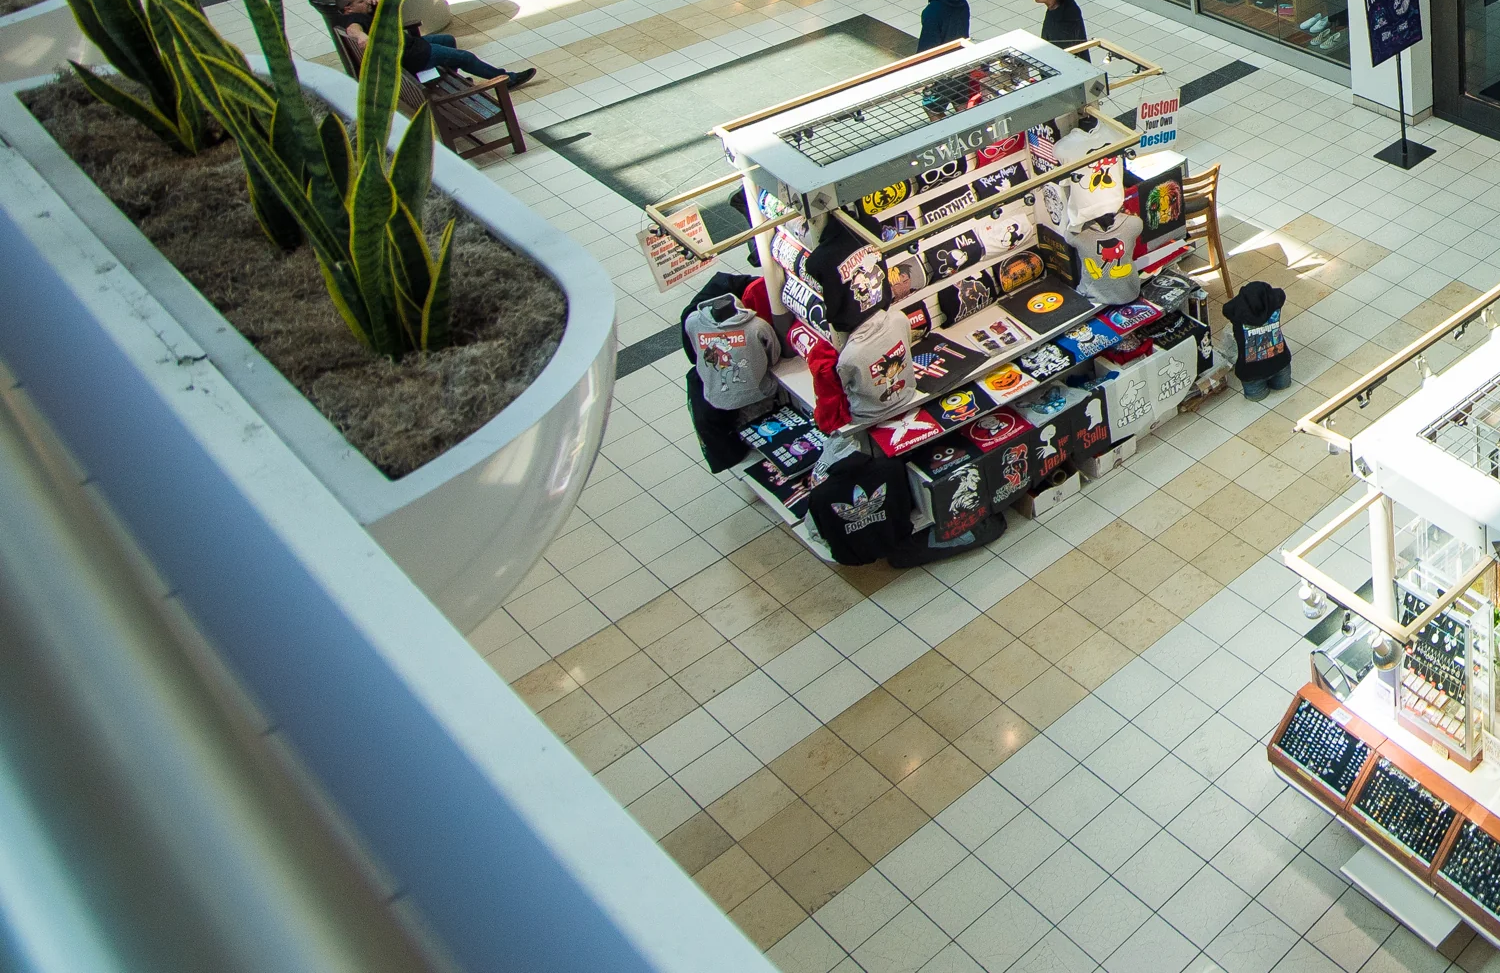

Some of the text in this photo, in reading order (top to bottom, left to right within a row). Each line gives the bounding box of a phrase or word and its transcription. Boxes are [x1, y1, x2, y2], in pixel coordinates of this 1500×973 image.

[1141, 98, 1178, 119] Custom
[1145, 116, 1173, 130] Your Own
[921, 117, 1013, 167] SWAG IT
[1140, 130, 1176, 148] Design
[926, 192, 976, 224] FORTNITE
[666, 273, 683, 286] Youth
[684, 266, 699, 277] Sizes
[789, 279, 812, 304] MAN
[782, 292, 808, 320] BEHIND
[1118, 310, 1154, 329] FORTNITE
[700, 334, 744, 345] Sume
[1032, 356, 1070, 377] BEAST
[1158, 378, 1192, 402] MINE
[1161, 370, 1188, 390] HE'S
[783, 407, 808, 426] DADDY
[1117, 401, 1152, 428] HERS
[1083, 425, 1107, 450] Sally
[1039, 451, 1067, 476] Jack
[845, 510, 887, 534] FORTNITE
